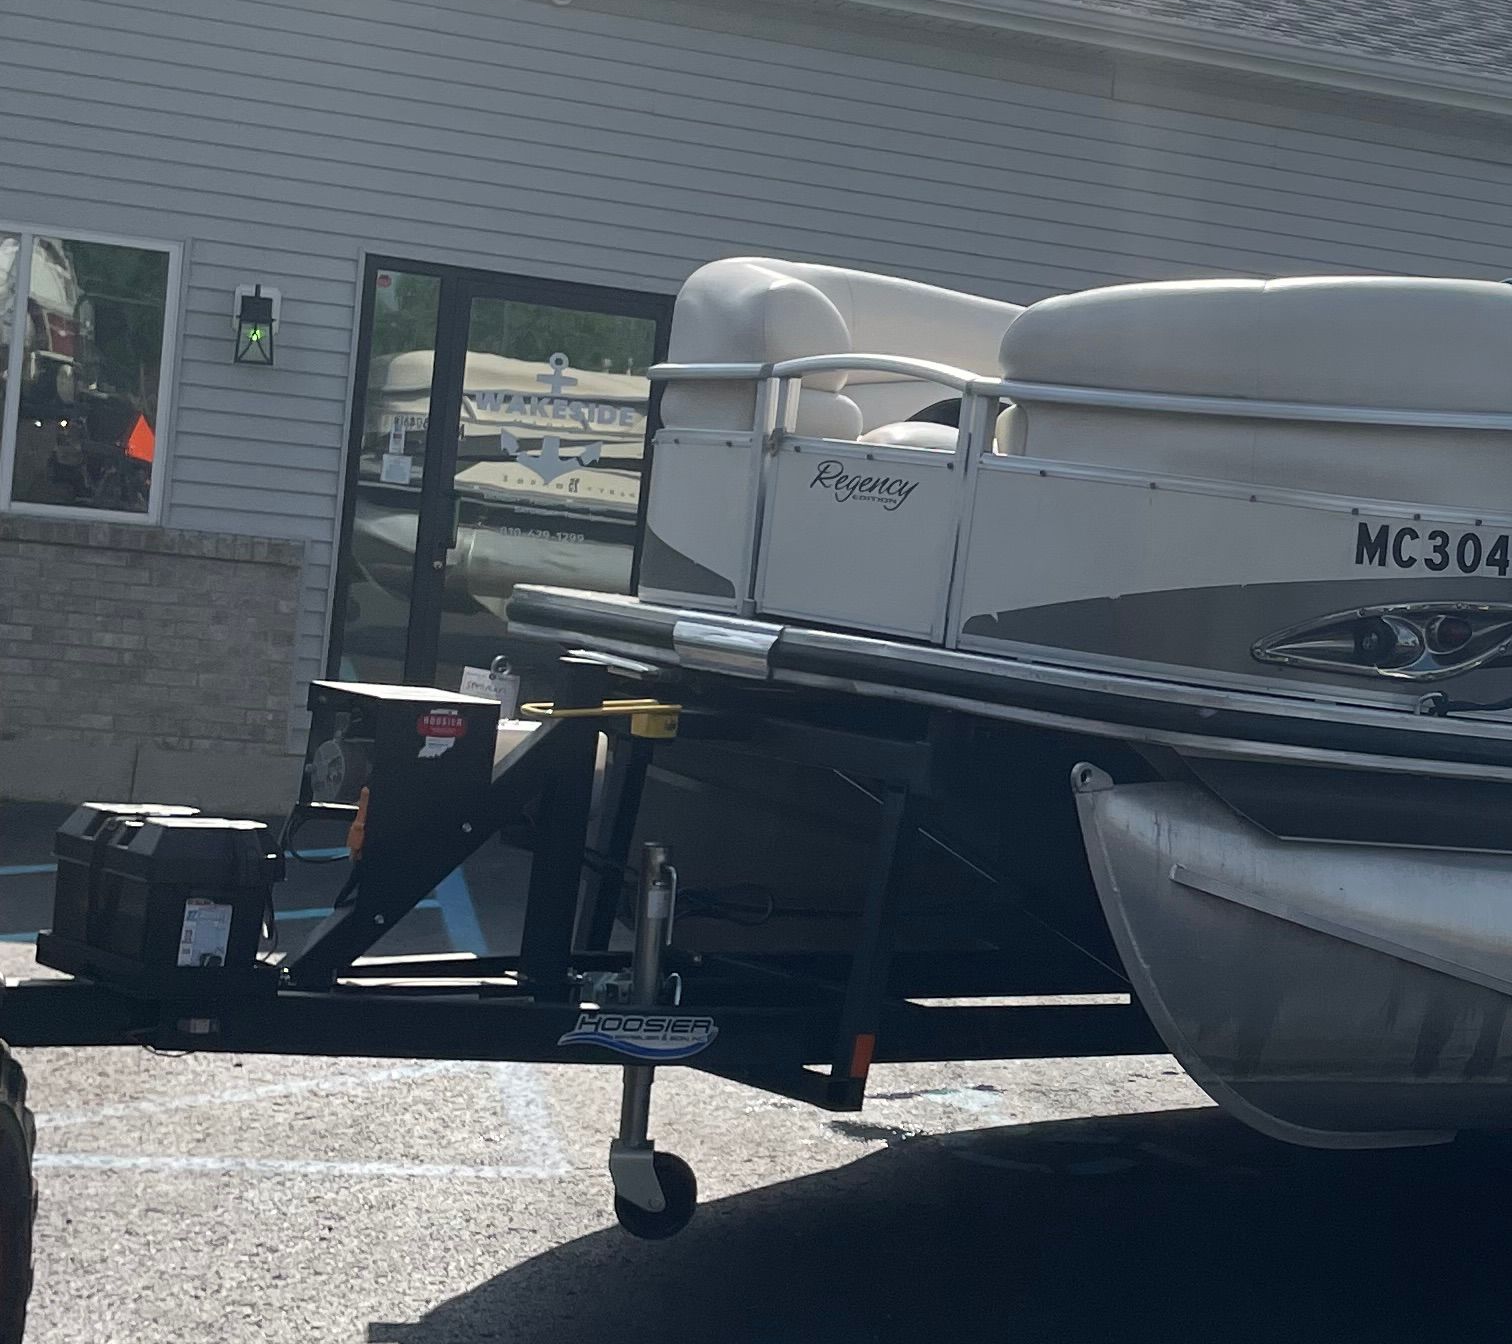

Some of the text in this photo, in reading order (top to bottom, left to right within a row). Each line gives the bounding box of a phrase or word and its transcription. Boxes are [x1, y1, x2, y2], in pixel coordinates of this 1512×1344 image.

[475, 391, 636, 427] WAKESIDE
[809, 459, 920, 511] Regency
[852, 494, 898, 505] EDITION
[423, 715, 463, 728] HOOSIER
[578, 1015, 712, 1034] HOOSIER
